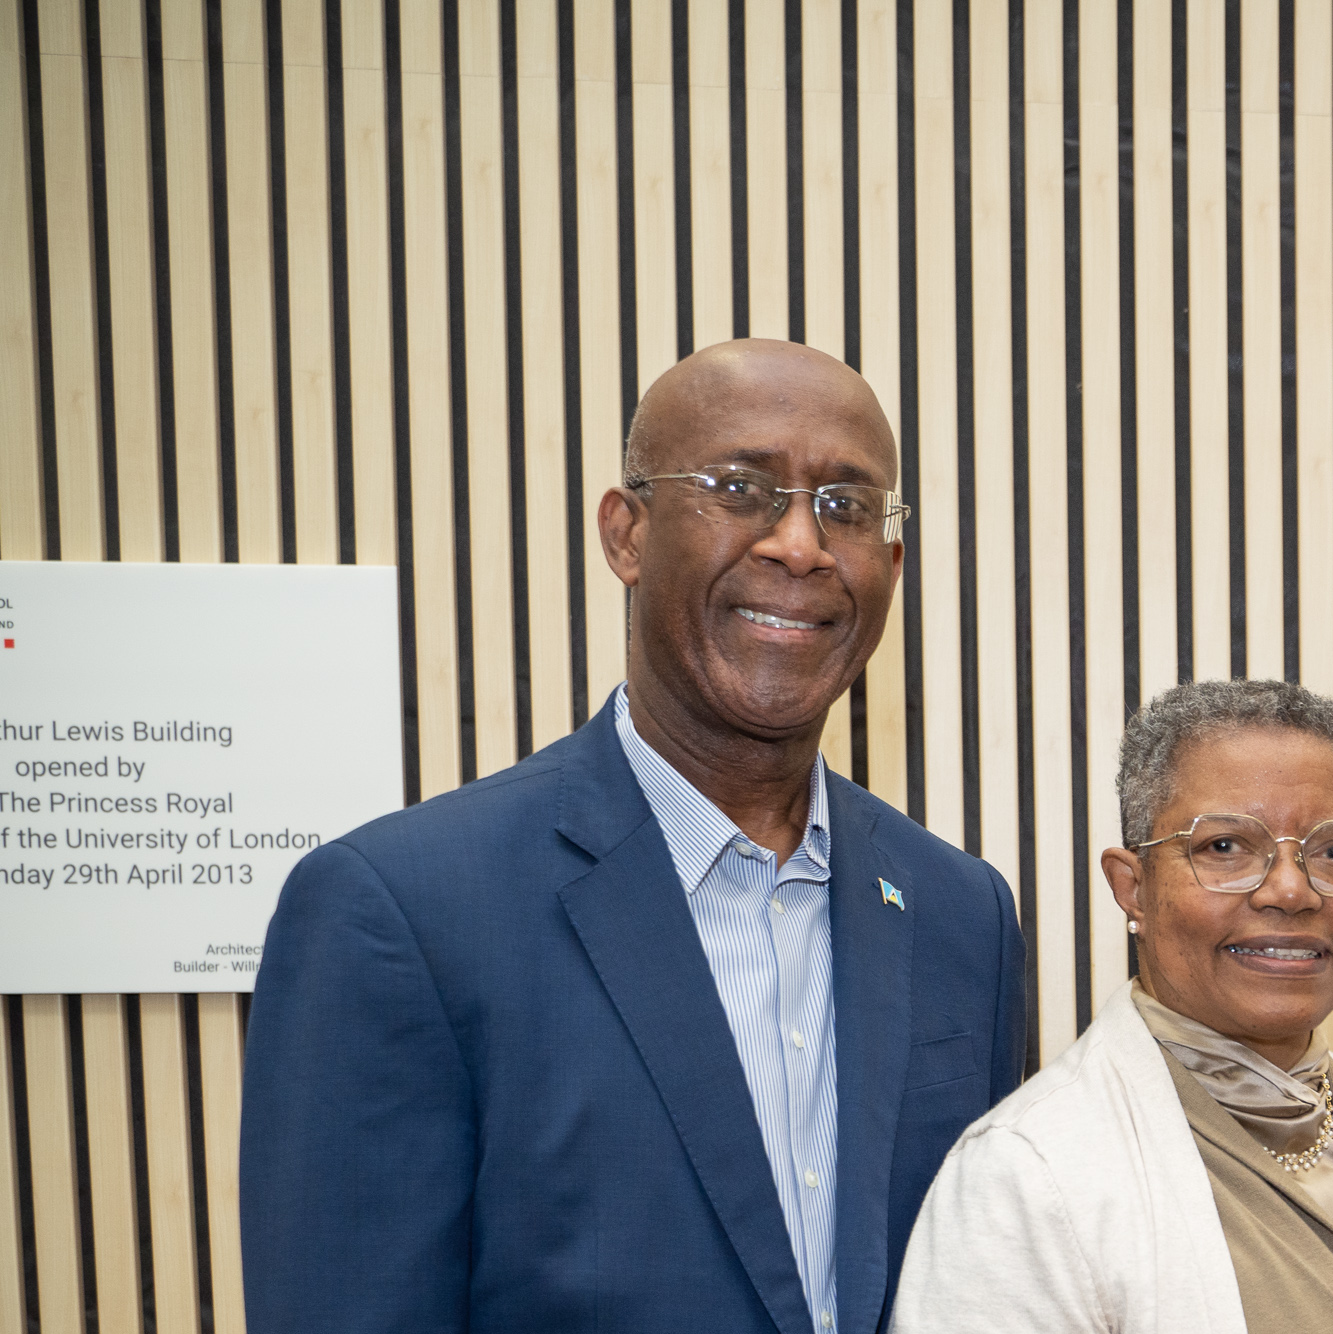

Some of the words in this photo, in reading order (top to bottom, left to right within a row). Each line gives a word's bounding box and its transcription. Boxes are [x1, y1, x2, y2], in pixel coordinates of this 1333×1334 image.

[0, 719, 44, 741] hur
[52, 720, 124, 742] Lewis
[133, 720, 232, 748] Building
[15, 755, 108, 782] opened
[117, 756, 145, 783] by
[0, 791, 41, 813] The
[50, 792, 157, 813] Princess
[167, 792, 233, 819] Royal
[17, 827, 57, 849] the
[66, 828, 188, 852] University
[196, 827, 221, 849] of
[230, 828, 320, 849] London
[63, 863, 118, 885] 29th
[127, 863, 183, 890] April
[192, 864, 253, 885] 2013
[174, 961, 220, 973] Builder
